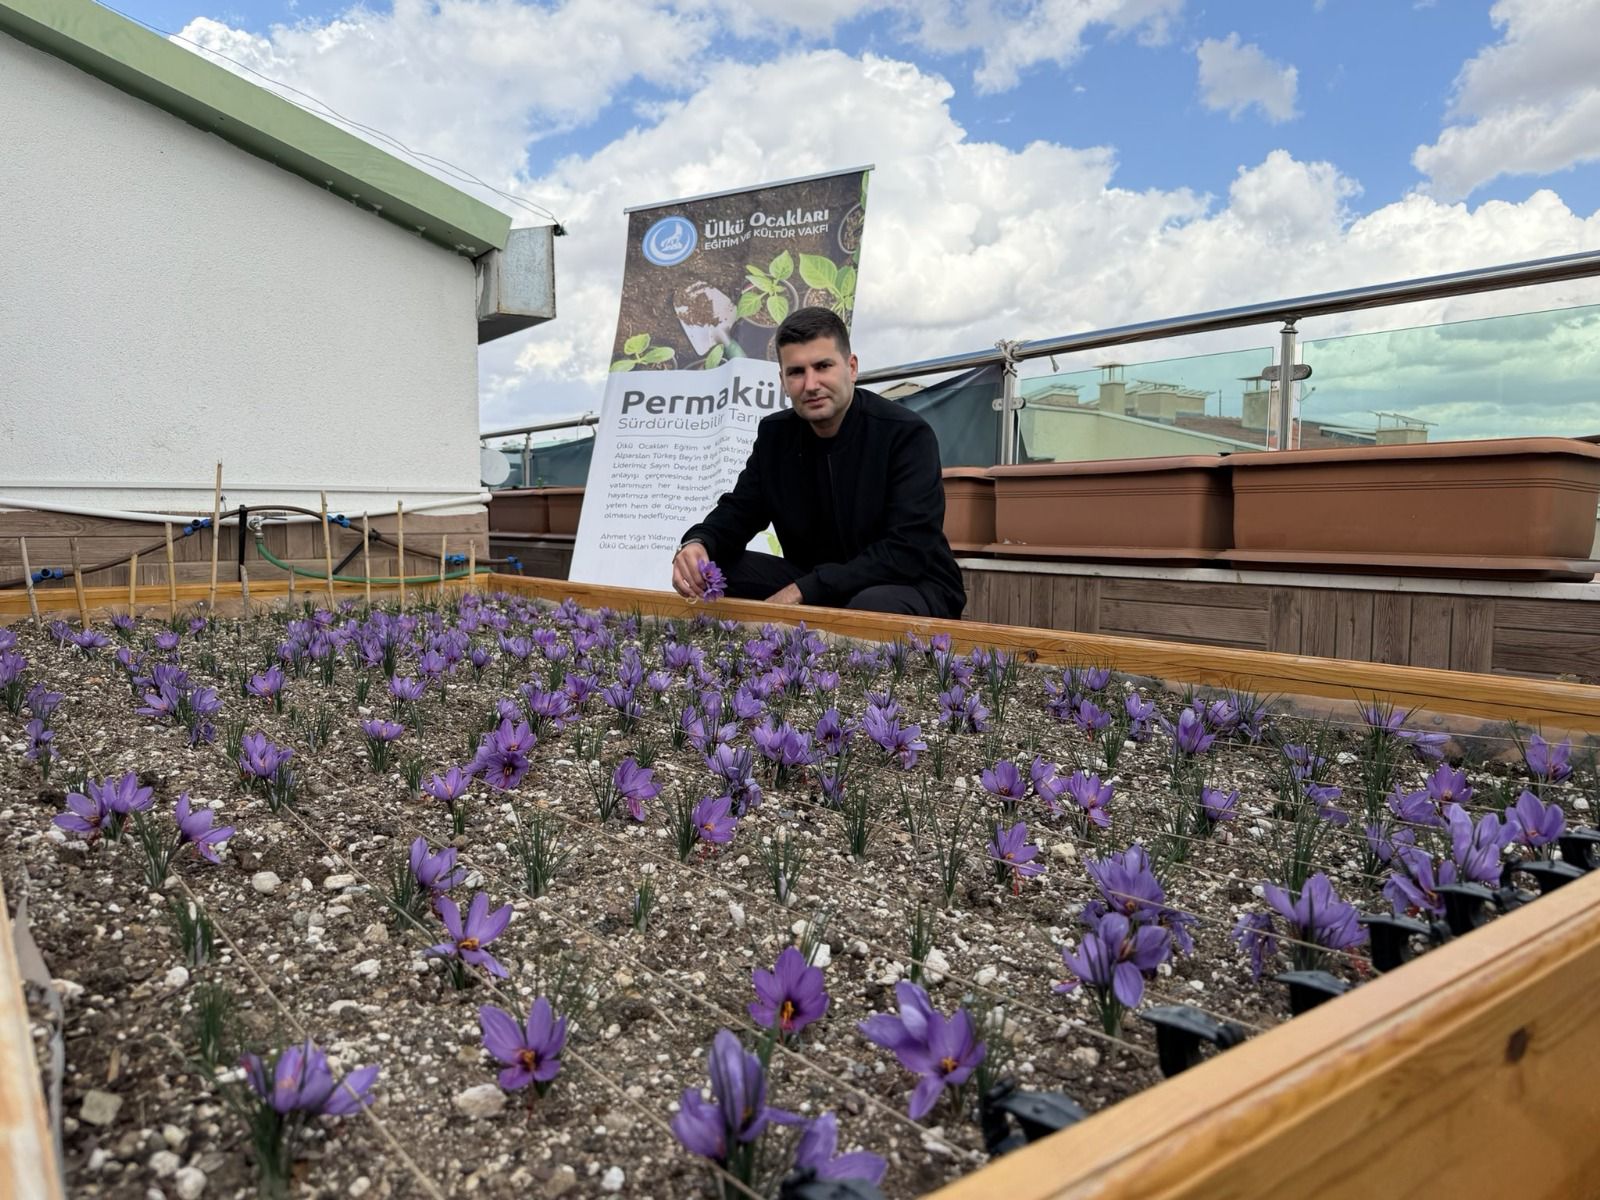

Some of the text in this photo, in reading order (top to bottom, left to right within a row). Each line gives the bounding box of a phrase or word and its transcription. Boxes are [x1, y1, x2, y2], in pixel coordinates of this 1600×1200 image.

[705, 236, 739, 250] EĞİTİM
[754, 224, 795, 238] KÜLTÜR
[618, 414, 725, 431] Sürdürülebilir
